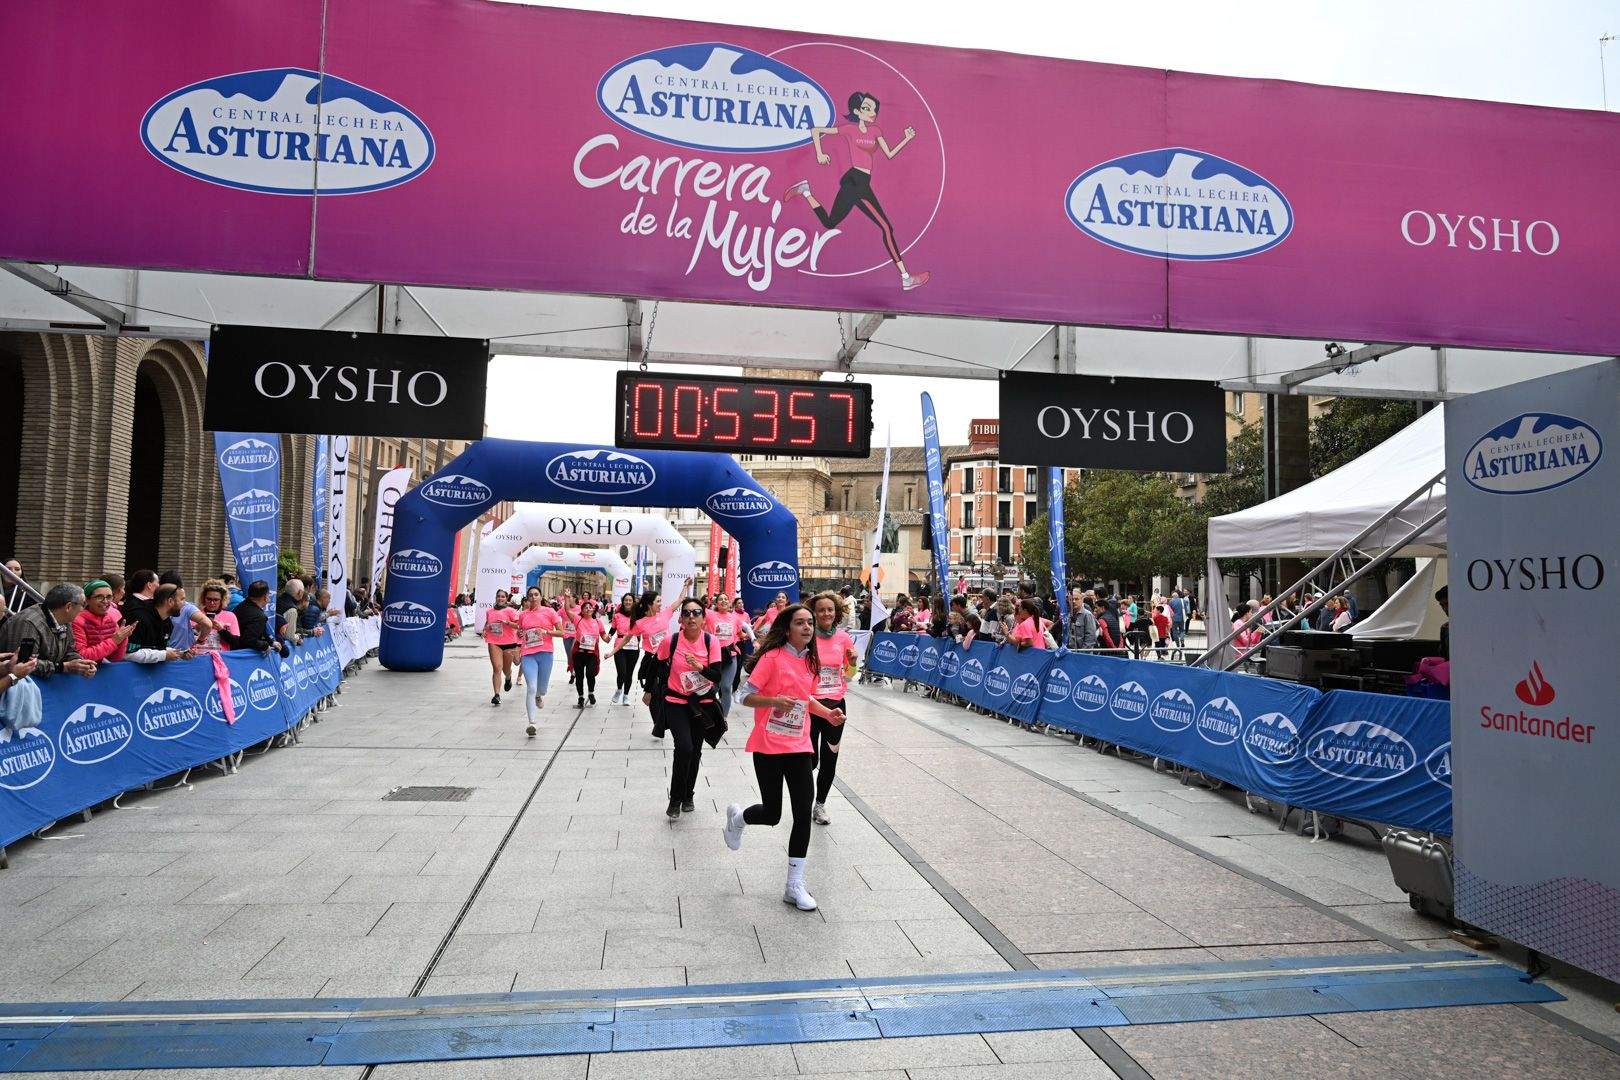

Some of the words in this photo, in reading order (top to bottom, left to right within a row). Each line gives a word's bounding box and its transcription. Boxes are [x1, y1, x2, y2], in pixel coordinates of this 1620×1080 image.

[654, 75, 730, 92] CENTRAL
[737, 82, 811, 99] LECHERA
[615, 74, 816, 131] ASTURIANA
[213, 106, 304, 125] CENTRAL
[313, 113, 405, 132] LECHERA
[163, 107, 413, 169] ASTURIANA
[572, 133, 771, 204] Carrera
[1119, 183, 1192, 198] CENTRAL
[1198, 188, 1270, 204] LECHERA
[1083, 183, 1277, 236] ASTURIANA
[620, 196, 658, 236] de
[666, 197, 693, 239] la
[684, 199, 842, 291] Mujer
[1400, 210, 1561, 256] OYSHO
[254, 361, 448, 407] OYSHO
[973, 424, 999, 436] TIBU
[1037, 405, 1194, 444] OYSHO
[1490, 441, 1533, 455] CENTRAL
[1536, 431, 1585, 447] LECHERA
[553, 461, 647, 485] ASTURIANA
[571, 461, 606, 469] CENTRAL
[1471, 443, 1592, 480] ASTURIANA
[424, 484, 486, 501] ASTURIANA
[711, 498, 769, 511] ASTURIANA
[548, 517, 633, 536] OYSHO
[391, 558, 438, 573] ASTURIANA
[481, 567, 507, 575] OYSHO
[751, 571, 796, 583] ASTURIANA
[1467, 553, 1605, 592] OYSHO
[383, 610, 432, 625] ASTURIANA
[1074, 686, 1105, 705] ASTURIANA
[1111, 693, 1145, 714] ASTURIANA
[143, 706, 200, 733] ASTURIANA
[1152, 701, 1191, 724] ASTURIANA
[1480, 705, 1596, 744] Santander
[65, 723, 129, 756] ASTURIANA
[1311, 738, 1406, 771] ASTURIANA
